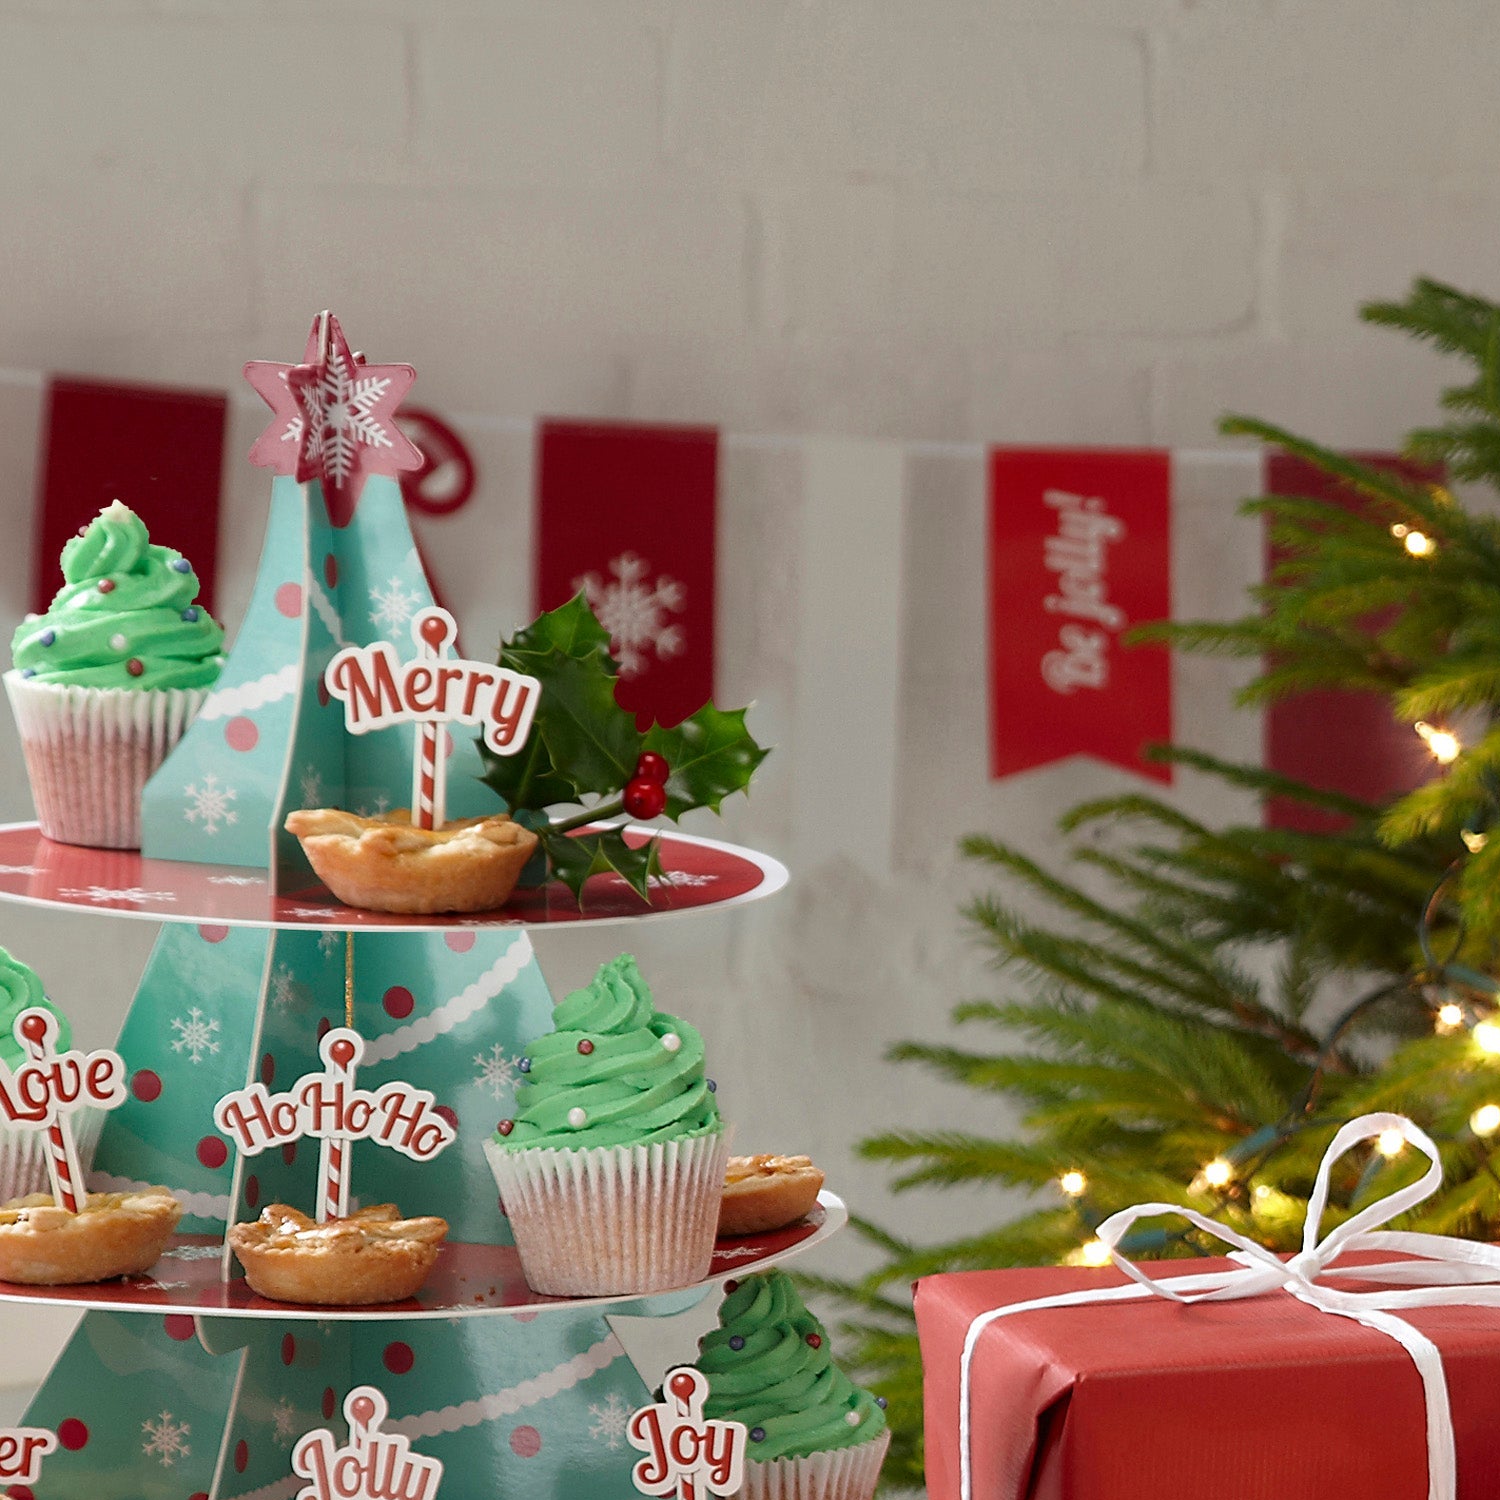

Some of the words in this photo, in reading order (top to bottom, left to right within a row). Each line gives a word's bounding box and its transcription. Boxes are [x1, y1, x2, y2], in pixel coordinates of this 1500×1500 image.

[1042, 488, 1126, 628] jolly!
[1040, 623, 1109, 694] Be
[333, 650, 530, 746] Merry
[0, 1436, 48, 1477] er
[631, 1408, 735, 1486] Joy
